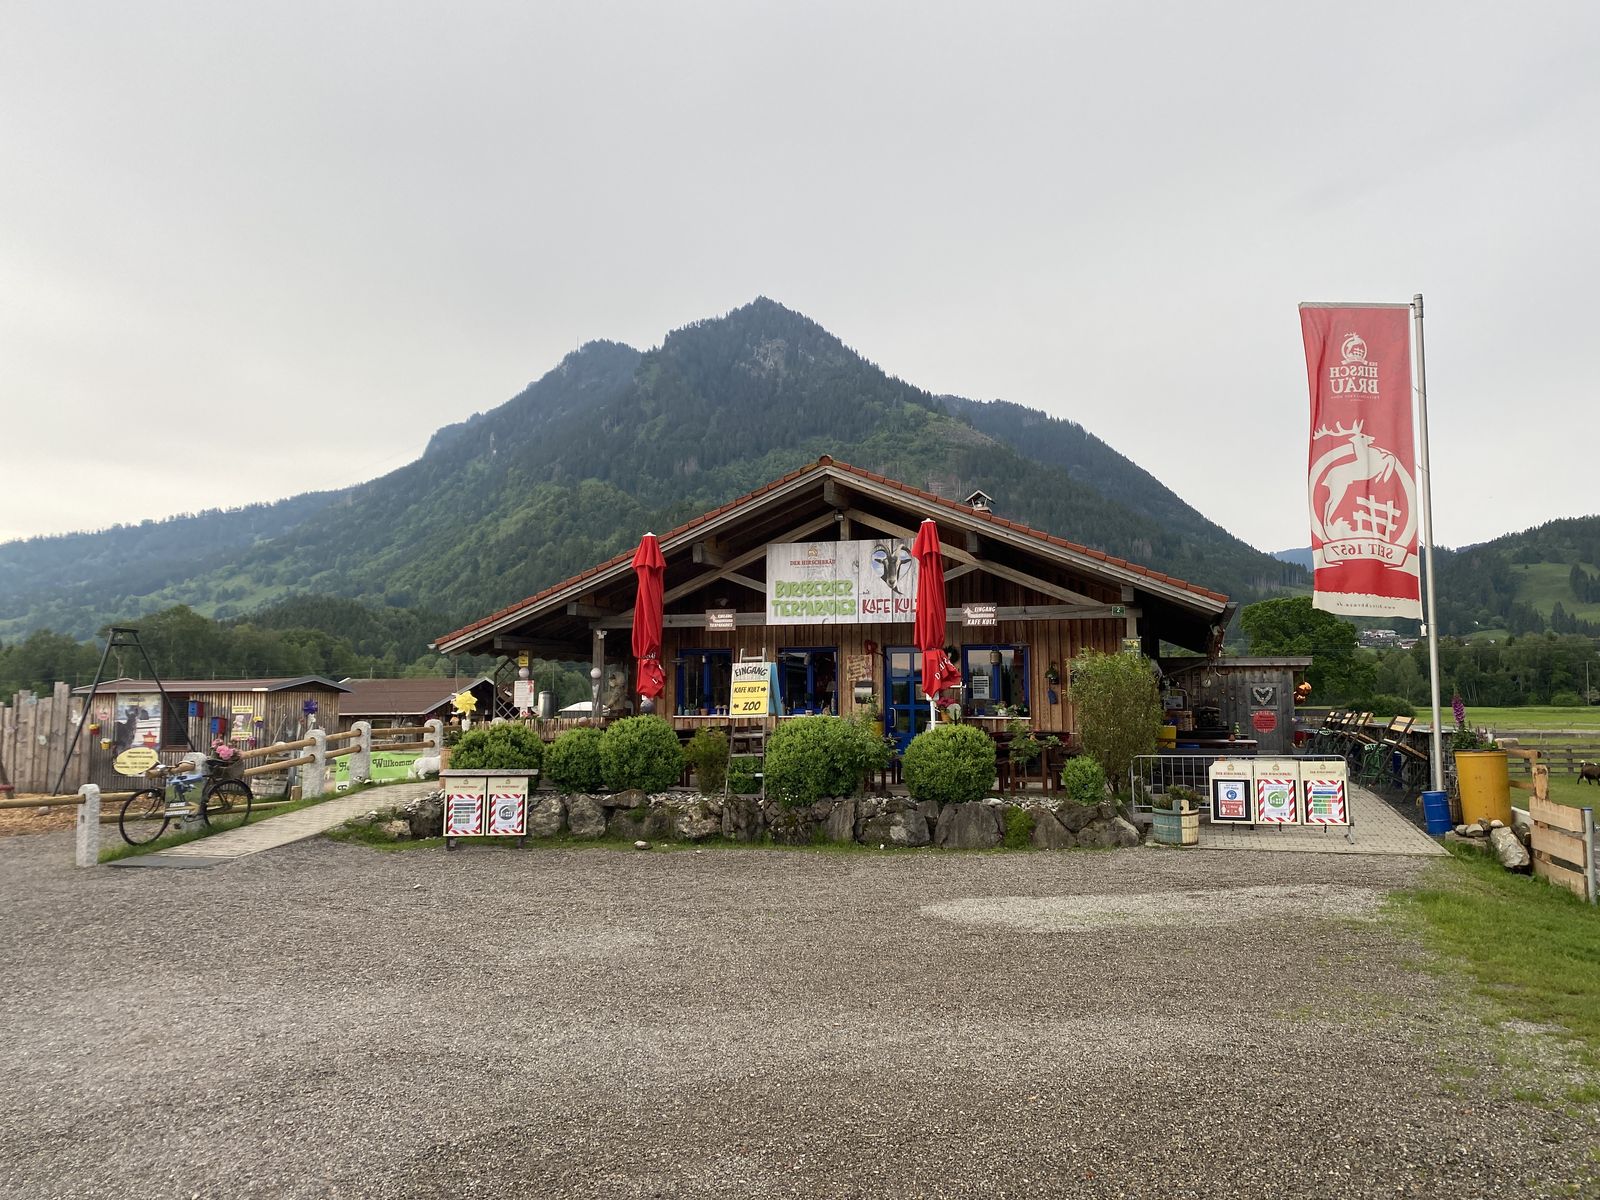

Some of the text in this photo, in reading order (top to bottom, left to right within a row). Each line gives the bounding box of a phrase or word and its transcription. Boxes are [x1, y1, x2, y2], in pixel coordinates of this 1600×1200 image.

[775, 580, 853, 598] BURGBERGER
[771, 598, 857, 617] TIERPARADIES
[862, 597, 918, 614] KAFE KUL
[734, 666, 768, 677] EINGANG
[733, 686, 747, 694] KAFE
[742, 700, 761, 711] ZOO
